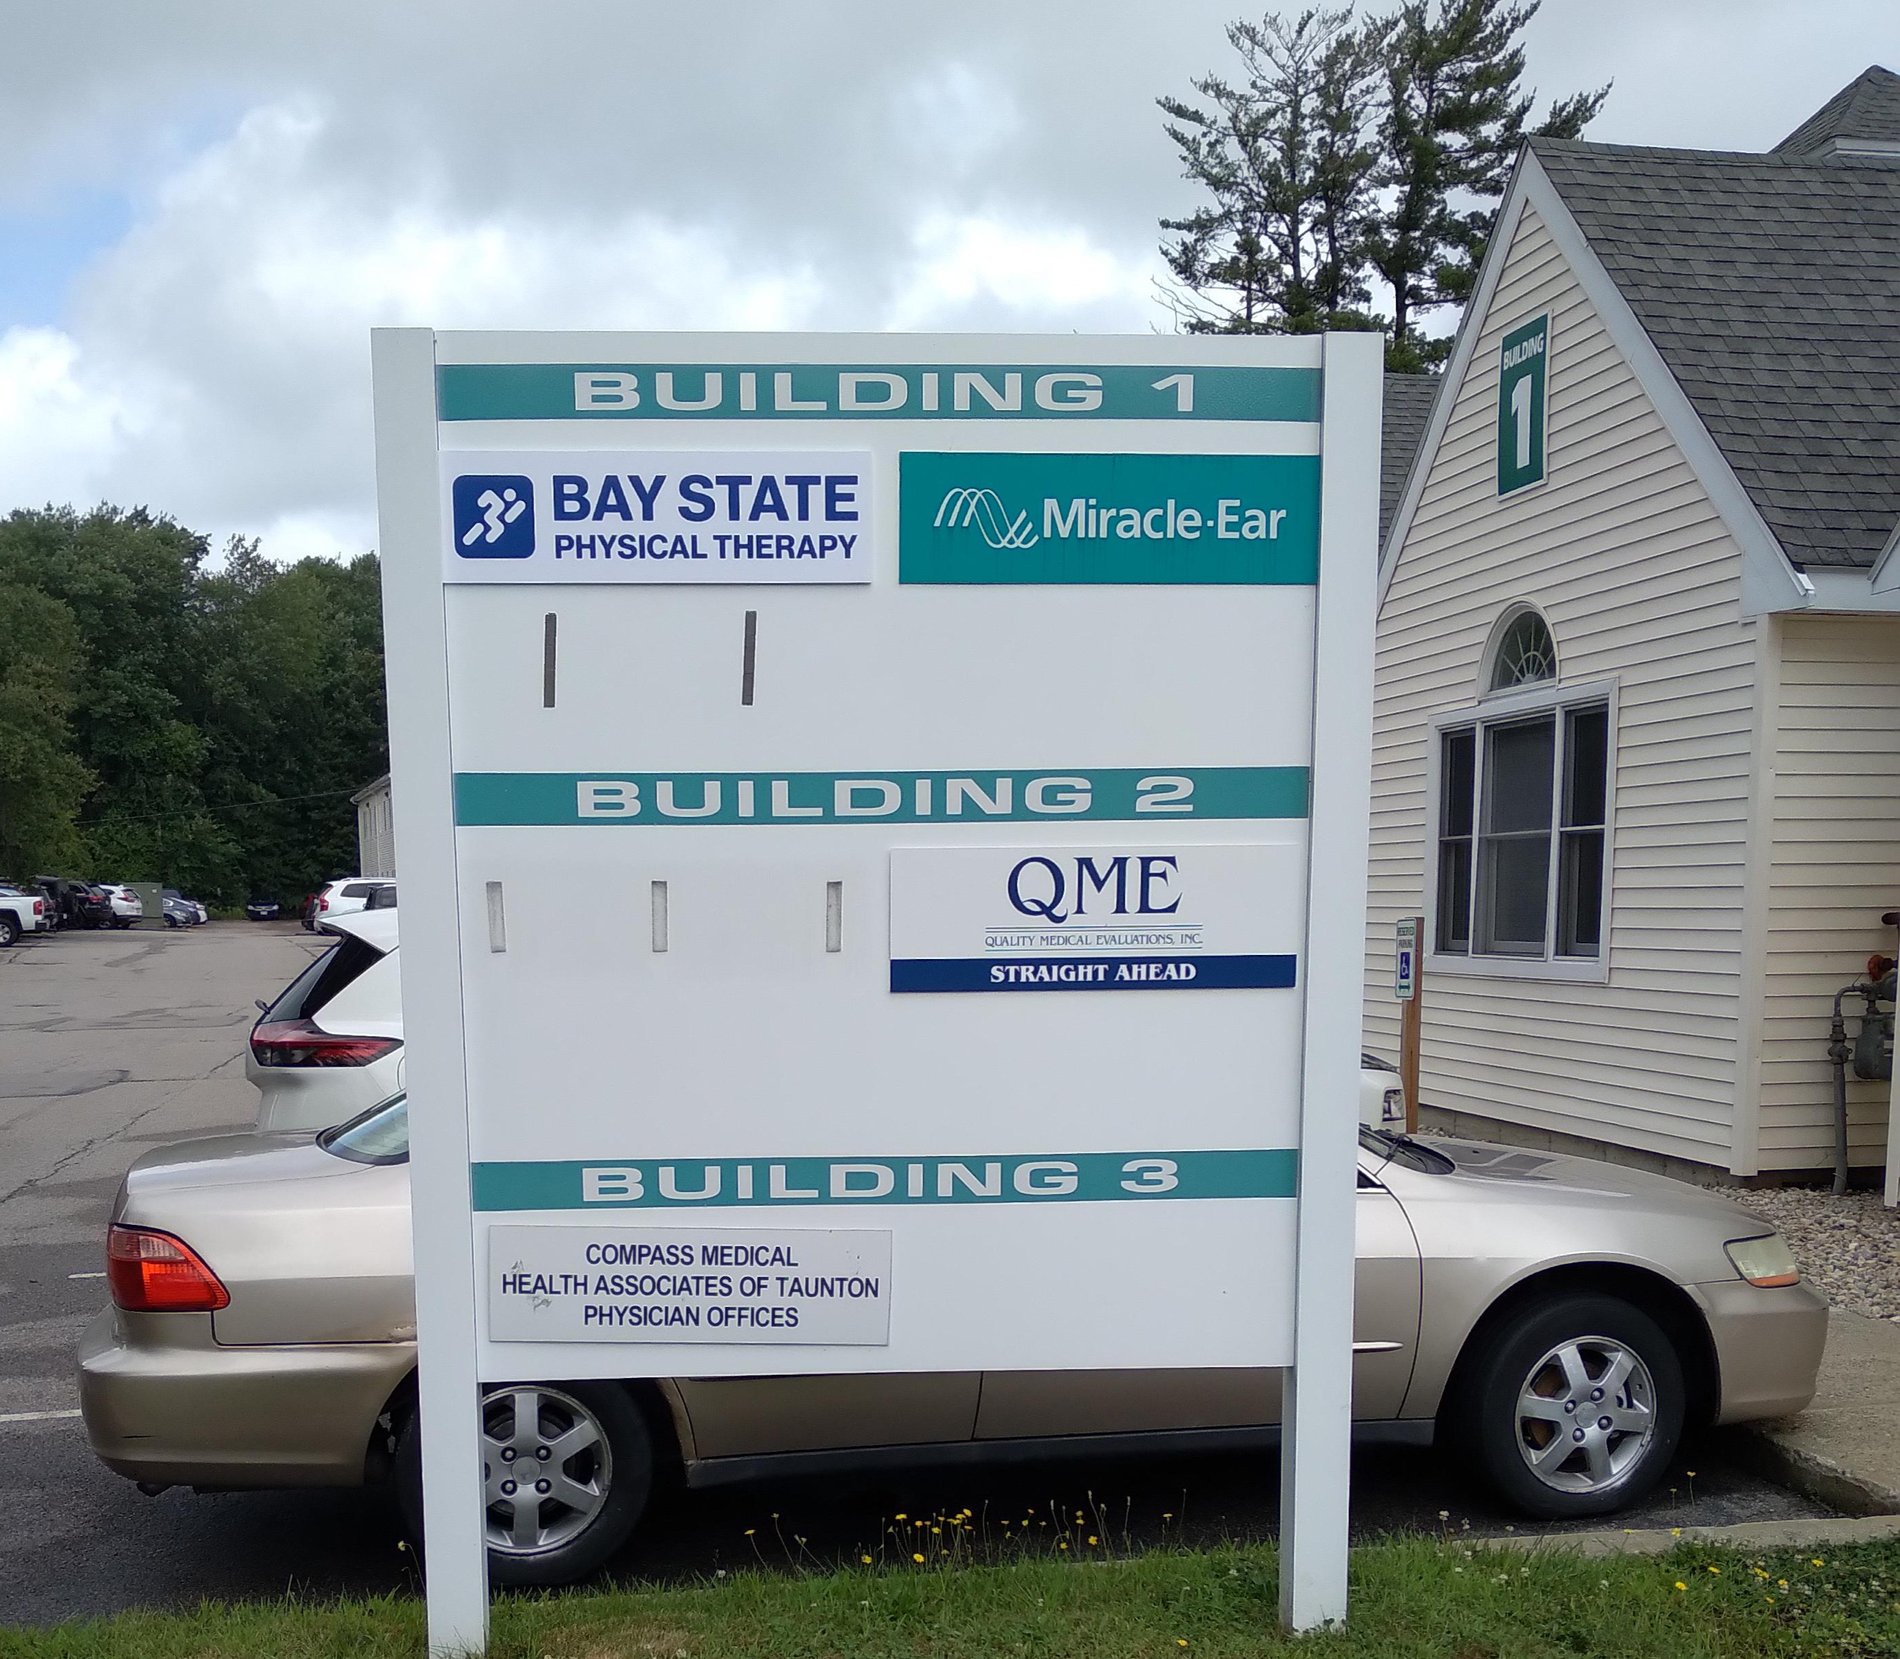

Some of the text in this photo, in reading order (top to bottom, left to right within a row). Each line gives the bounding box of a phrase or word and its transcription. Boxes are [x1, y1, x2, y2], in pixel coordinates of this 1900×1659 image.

[1503, 332, 1545, 371] BUILDING
[573, 371, 1195, 413] BUILDING 1
[1511, 374, 1532, 469] 1
[552, 474, 859, 522] BAY STATE
[554, 534, 858, 560] PHYSICAL THERAPY
[576, 775, 1195, 818] BUILDING 2
[1007, 855, 1183, 924] QME
[985, 933, 1203, 947] QUALITY MEDICAL EVALUATIONS, INC.
[990, 963, 1197, 983] STRAIGHT AHEAD
[580, 1158, 1180, 1202] BUILDING 3
[585, 1243, 799, 1267] COMPASS MEDICAL
[502, 1274, 879, 1298] HEALTH ASSOCIATES OF TAUNTON
[584, 1305, 799, 1328] PHYSICIAN OFFICES
